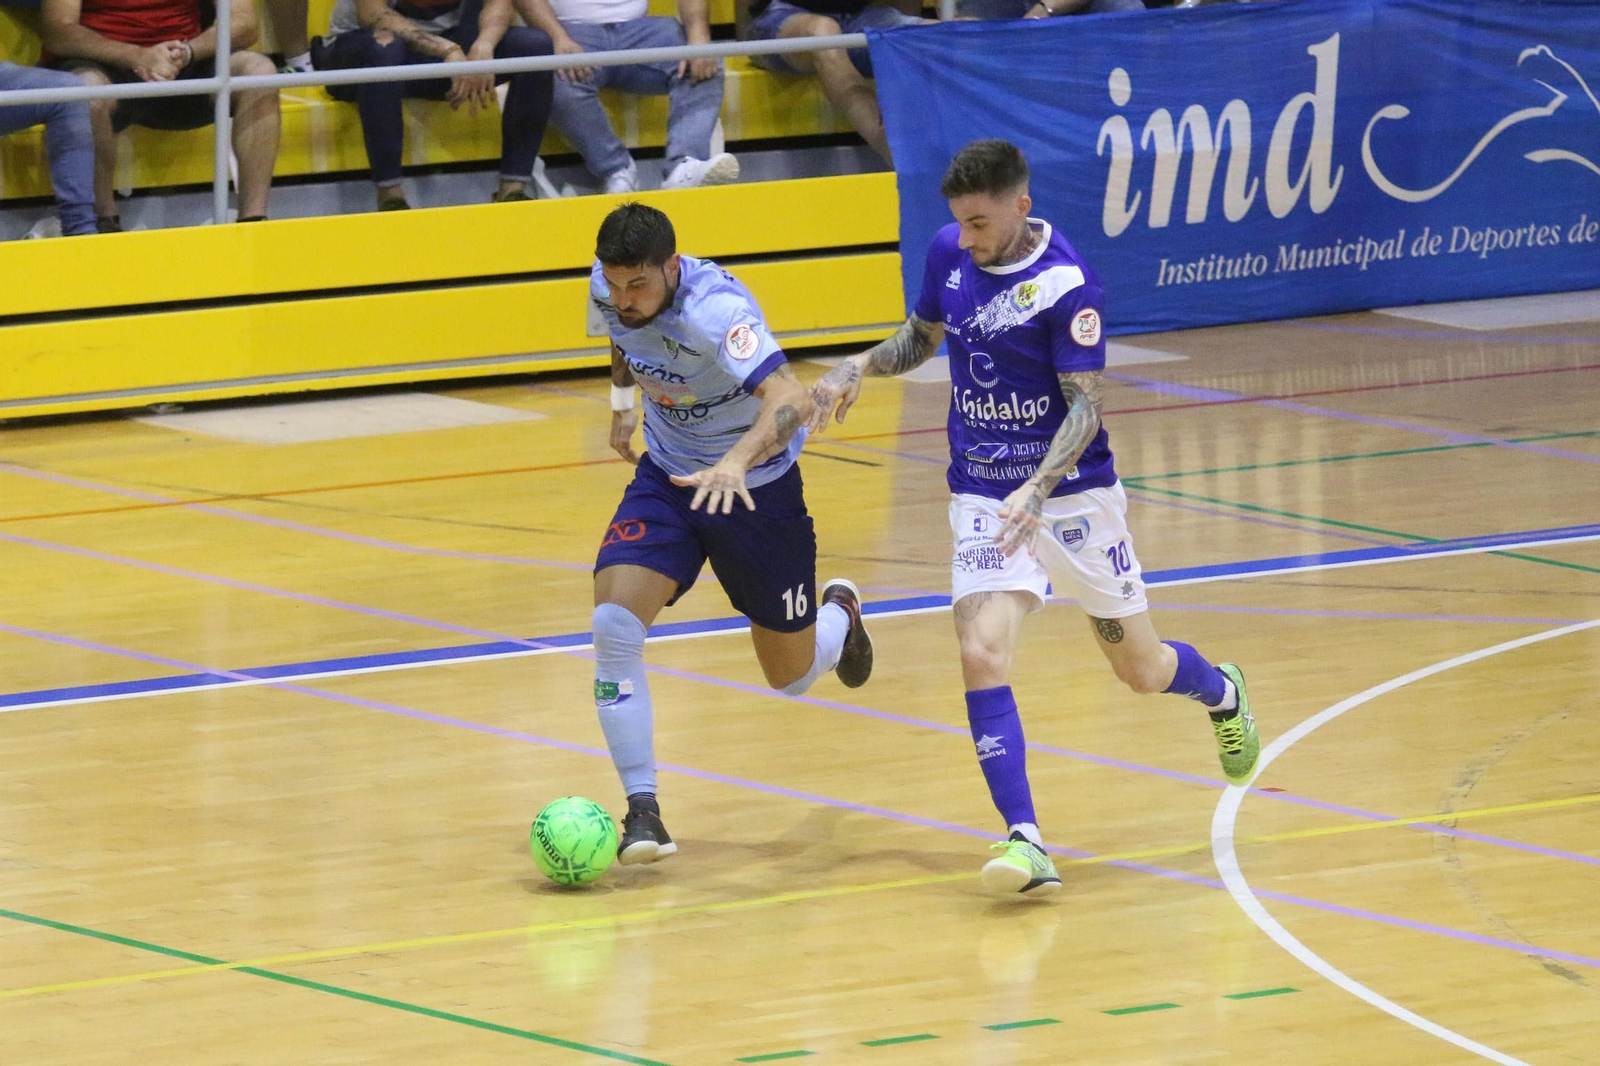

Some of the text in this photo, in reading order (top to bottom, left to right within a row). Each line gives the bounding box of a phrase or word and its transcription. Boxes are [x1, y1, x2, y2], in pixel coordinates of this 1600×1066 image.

[1097, 32, 1344, 237] imd
[1156, 213, 1600, 286] Instituto Municipal de Deportes de
[962, 388, 1050, 427] hidalgo
[966, 554, 1005, 566] CIUDAD
[977, 561, 1004, 570] REAL
[1106, 540, 1132, 577] 10
[782, 583, 808, 620] 16
